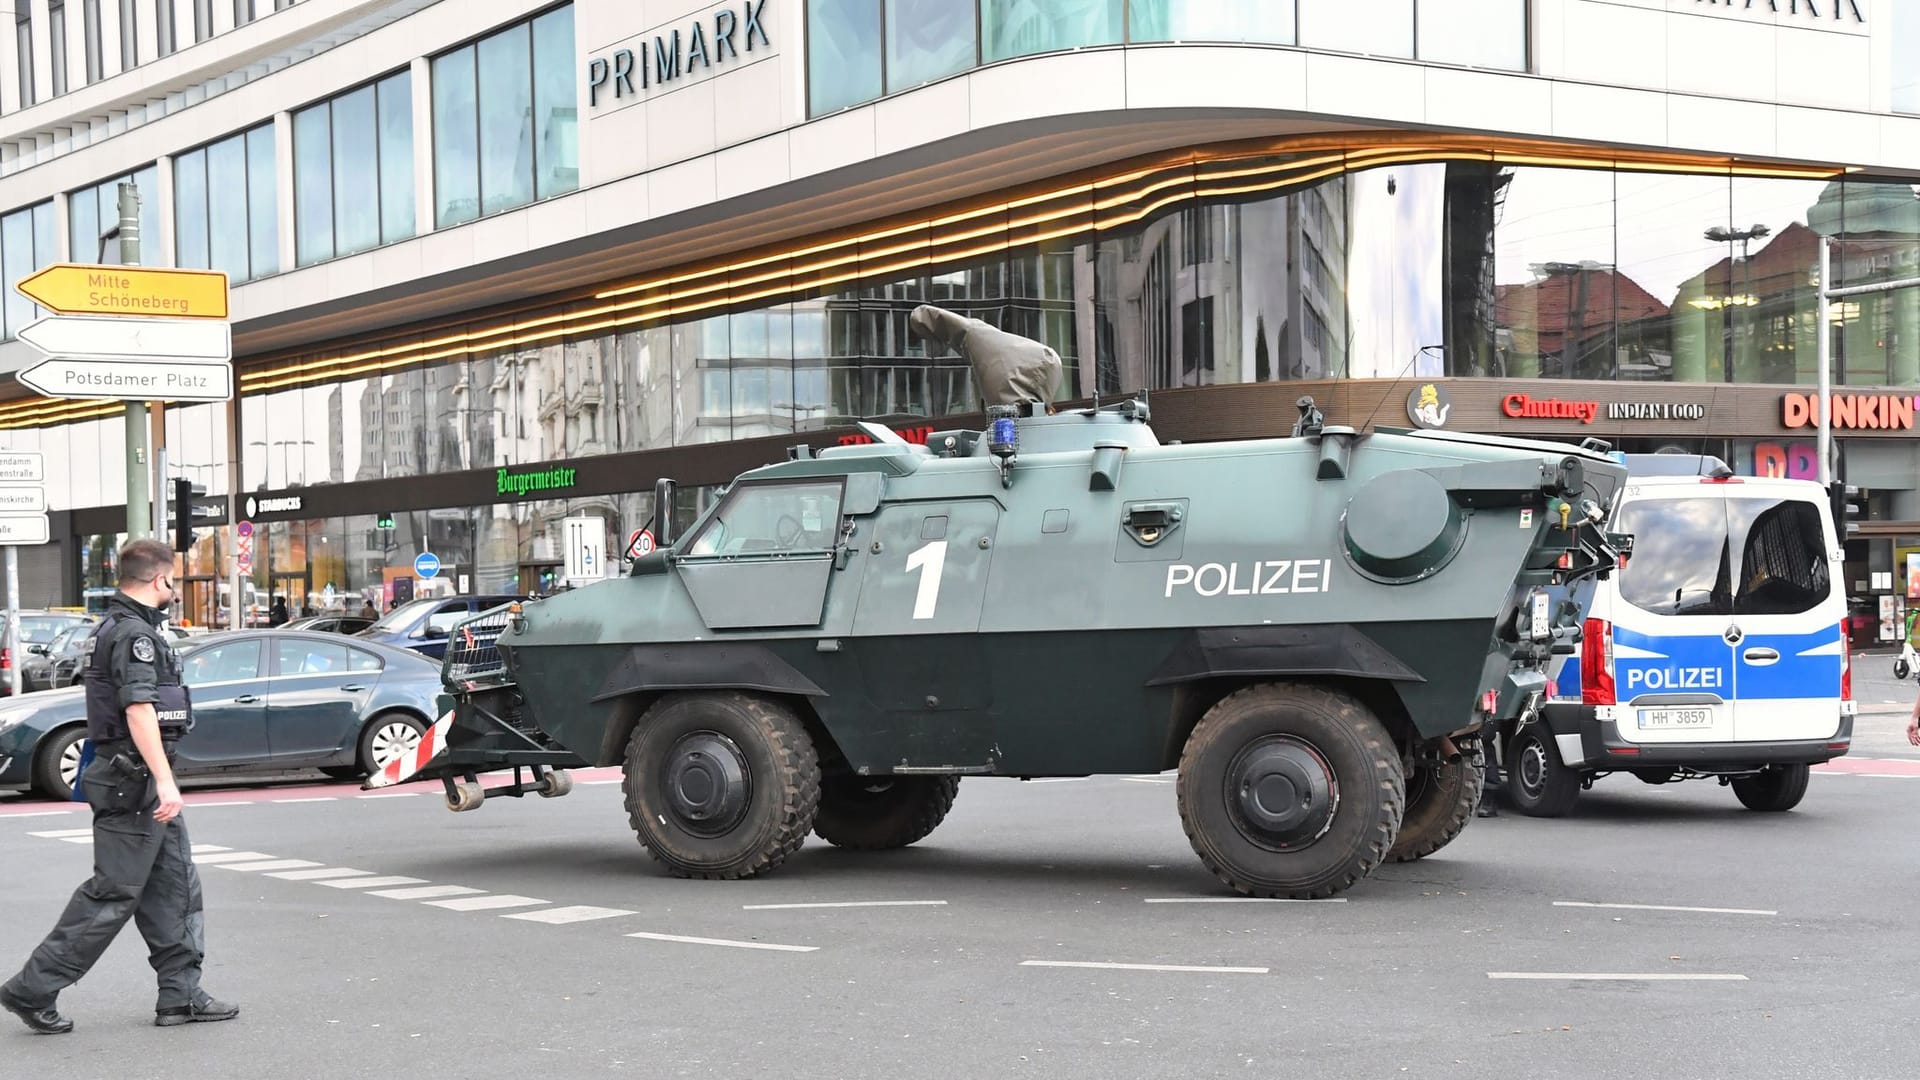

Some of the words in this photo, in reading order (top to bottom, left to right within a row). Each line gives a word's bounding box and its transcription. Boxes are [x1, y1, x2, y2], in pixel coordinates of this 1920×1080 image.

[588, 0, 770, 107] PRIMARK
[88, 273, 130, 289] Mitte
[89, 292, 189, 312] Schöneberg
[65, 370, 157, 387] Potsdamer
[166, 373, 207, 388] Platz
[1502, 393, 1600, 424] Chutney
[1608, 403, 1661, 419] INDIAN
[496, 465, 576, 496] Burgermeister
[1628, 486, 1641, 496] 32
[258, 496, 301, 512] STARBUCKS
[635, 537, 650, 551] 30
[904, 540, 949, 620] 1
[1164, 559, 1332, 598] POLIZEI
[1627, 667, 1723, 689] POLIZEI
[1651, 711, 1669, 724] HH
[1676, 711, 1706, 724] 3859
